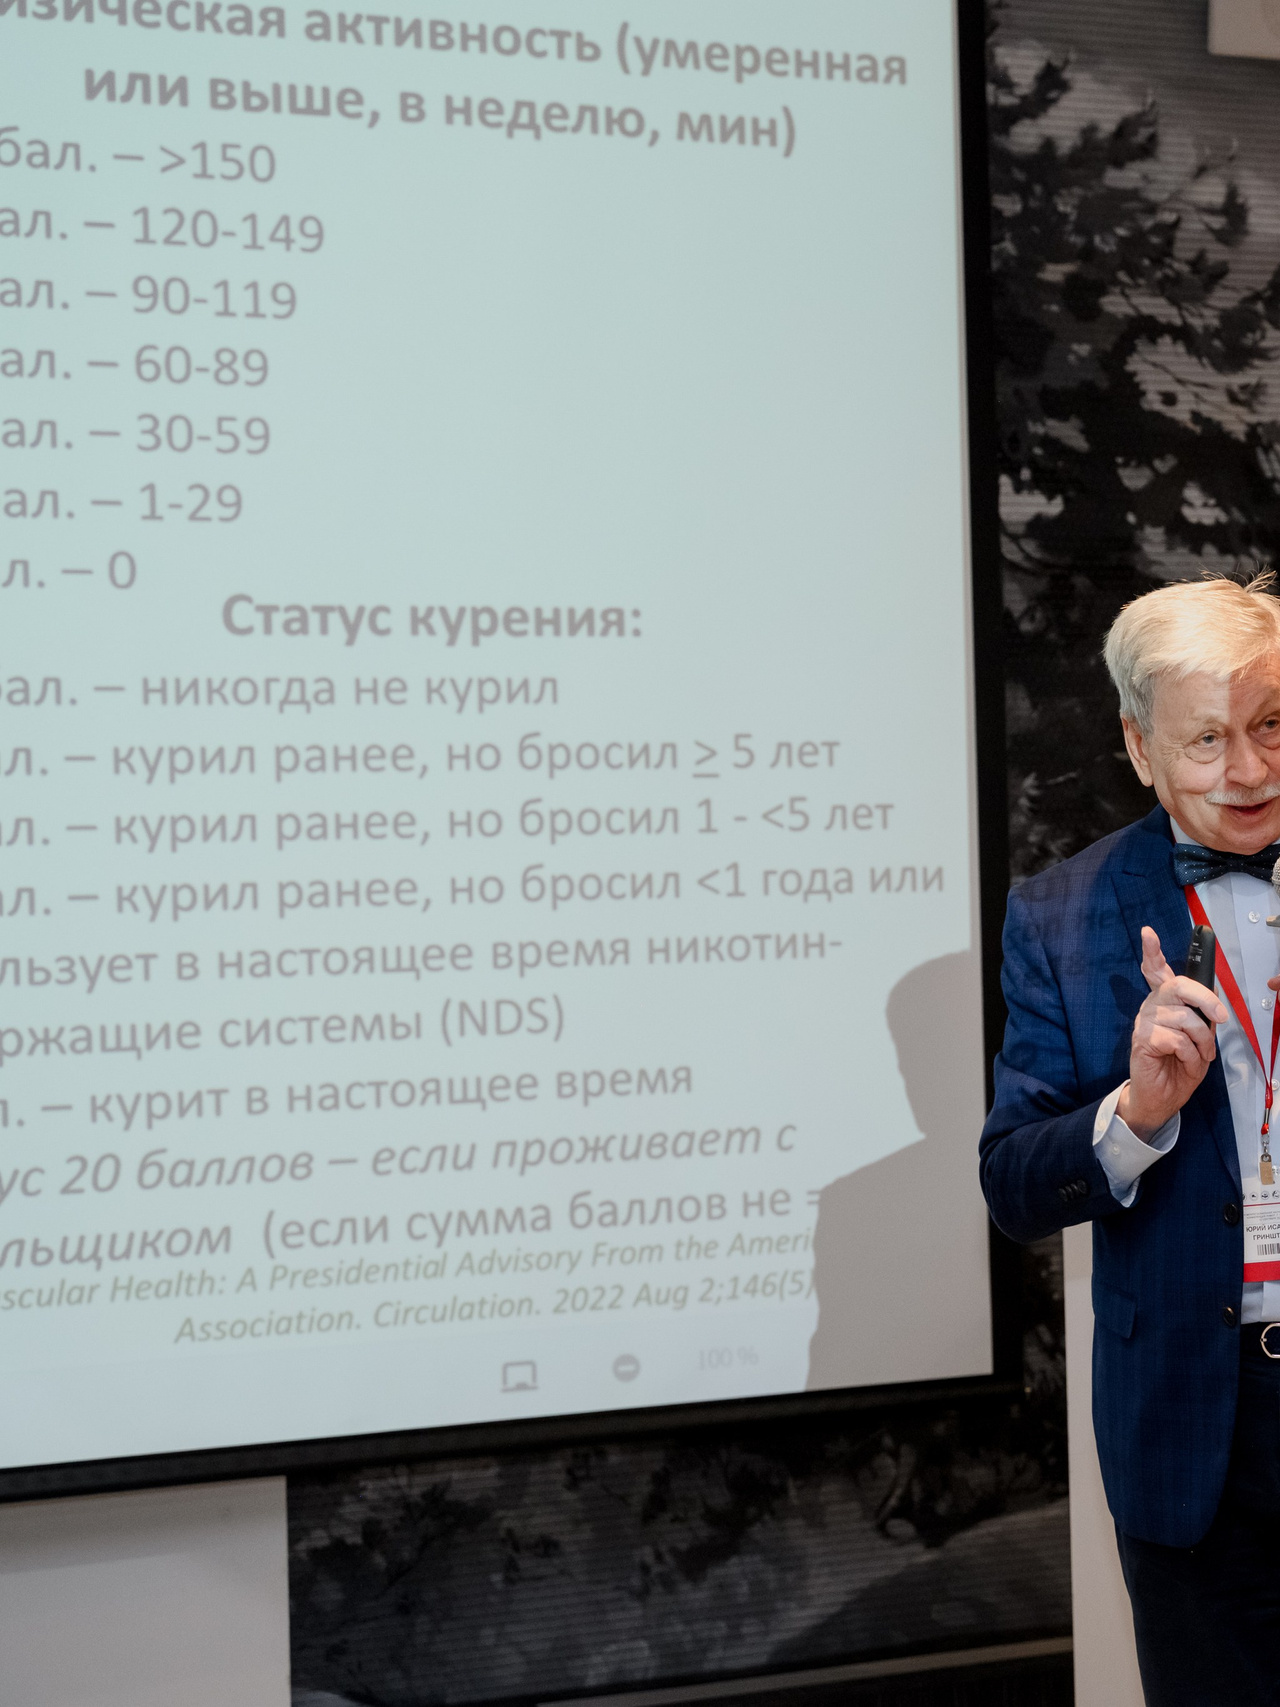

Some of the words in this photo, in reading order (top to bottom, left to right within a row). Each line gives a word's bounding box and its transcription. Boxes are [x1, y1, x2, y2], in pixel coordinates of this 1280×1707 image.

[304, 7, 603, 63] активность
[617, 22, 906, 85] (умеренная
[85, 69, 188, 107] или
[209, 78, 380, 128] выше,
[399, 92, 426, 123] в
[445, 95, 659, 147] неделю,
[677, 106, 795, 158] мин)
[160, 141, 276, 183] >150
[133, 206, 324, 253] 120-149
[132, 275, 297, 319] 90-119
[135, 344, 269, 387] 60-89
[137, 413, 270, 455] 30-59
[141, 483, 242, 523] 1-29
[108, 551, 137, 589] 0
[222, 593, 391, 646] Статус
[410, 606, 641, 647] курения:
[142, 677, 335, 714] никогда
[355, 677, 408, 705] не
[426, 677, 558, 714] курил
[113, 746, 255, 785] курил
[275, 744, 428, 783] ранее,
[447, 743, 501, 771] но
[518, 731, 677, 779] бросил
[733, 733, 755, 769] 5
[770, 741, 840, 768] лет
[115, 814, 257, 853] курил
[276, 811, 430, 851] ранее,
[449, 809, 503, 838] но
[519, 797, 679, 845] бросил
[698, 798, 718, 833] 1
[761, 796, 810, 832] <5
[825, 804, 894, 831] лет
[116, 882, 258, 922] курил
[278, 878, 431, 919] ранее,
[450, 876, 504, 904] но
[521, 863, 680, 911] бросил
[697, 862, 746, 897] <1
[763, 867, 853, 903] года
[870, 866, 944, 893] или
[176, 952, 200, 981] в
[218, 943, 473, 981] настоящее
[492, 938, 630, 978] время
[648, 933, 842, 964] никотин-
[219, 1012, 421, 1048] системы
[441, 994, 564, 1047] (NDS)
[90, 1088, 229, 1131] курит
[246, 1086, 269, 1115] в
[287, 1073, 539, 1113] настоящее
[556, 1066, 692, 1107] время
[60, 1153, 121, 1195] 20
[137, 1148, 314, 1190] баллов
[371, 1143, 476, 1176] если
[492, 1126, 761, 1176] проживает
[776, 1124, 796, 1152] с
[263, 1210, 388, 1259] (если
[406, 1204, 551, 1248] сумма
[569, 1190, 727, 1230] баллов
[742, 1189, 791, 1218] не
[1246, 1224, 1266, 1232] ЮРИЙ
[0, 1279, 100, 1311] scular
[110, 1269, 226, 1302] Health:
[236, 1267, 257, 1293] A
[269, 1252, 448, 1292] Presidential
[455, 1247, 582, 1277] Advisory
[591, 1242, 664, 1267] From
[674, 1235, 719, 1261] the
[174, 1307, 361, 1344] Association.
[373, 1294, 540, 1328] Circulation.
[552, 1284, 624, 1314] 2022
[632, 1283, 689, 1311] Aug
